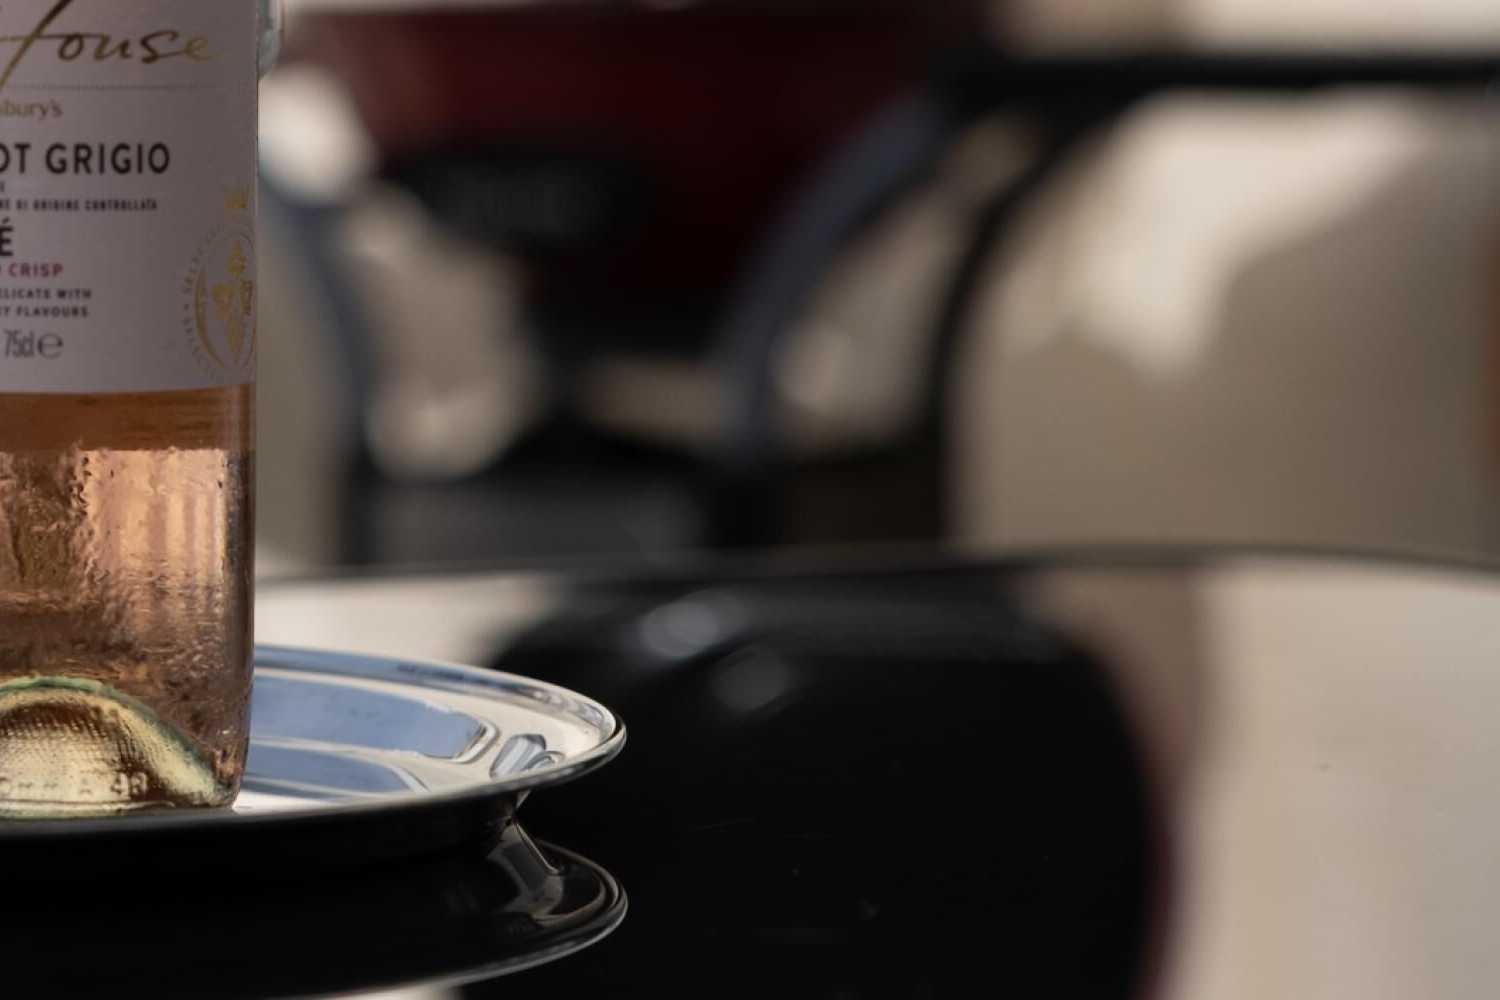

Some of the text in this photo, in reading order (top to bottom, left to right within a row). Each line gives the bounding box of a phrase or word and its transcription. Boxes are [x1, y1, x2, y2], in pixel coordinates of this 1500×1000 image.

[45, 142, 171, 175] GRIGIO
[85, 199, 157, 211] CONTROLLATA
[8, 263, 64, 278] CRISP
[56, 288, 92, 300] WITH
[16, 305, 89, 318] FLAVOURS
